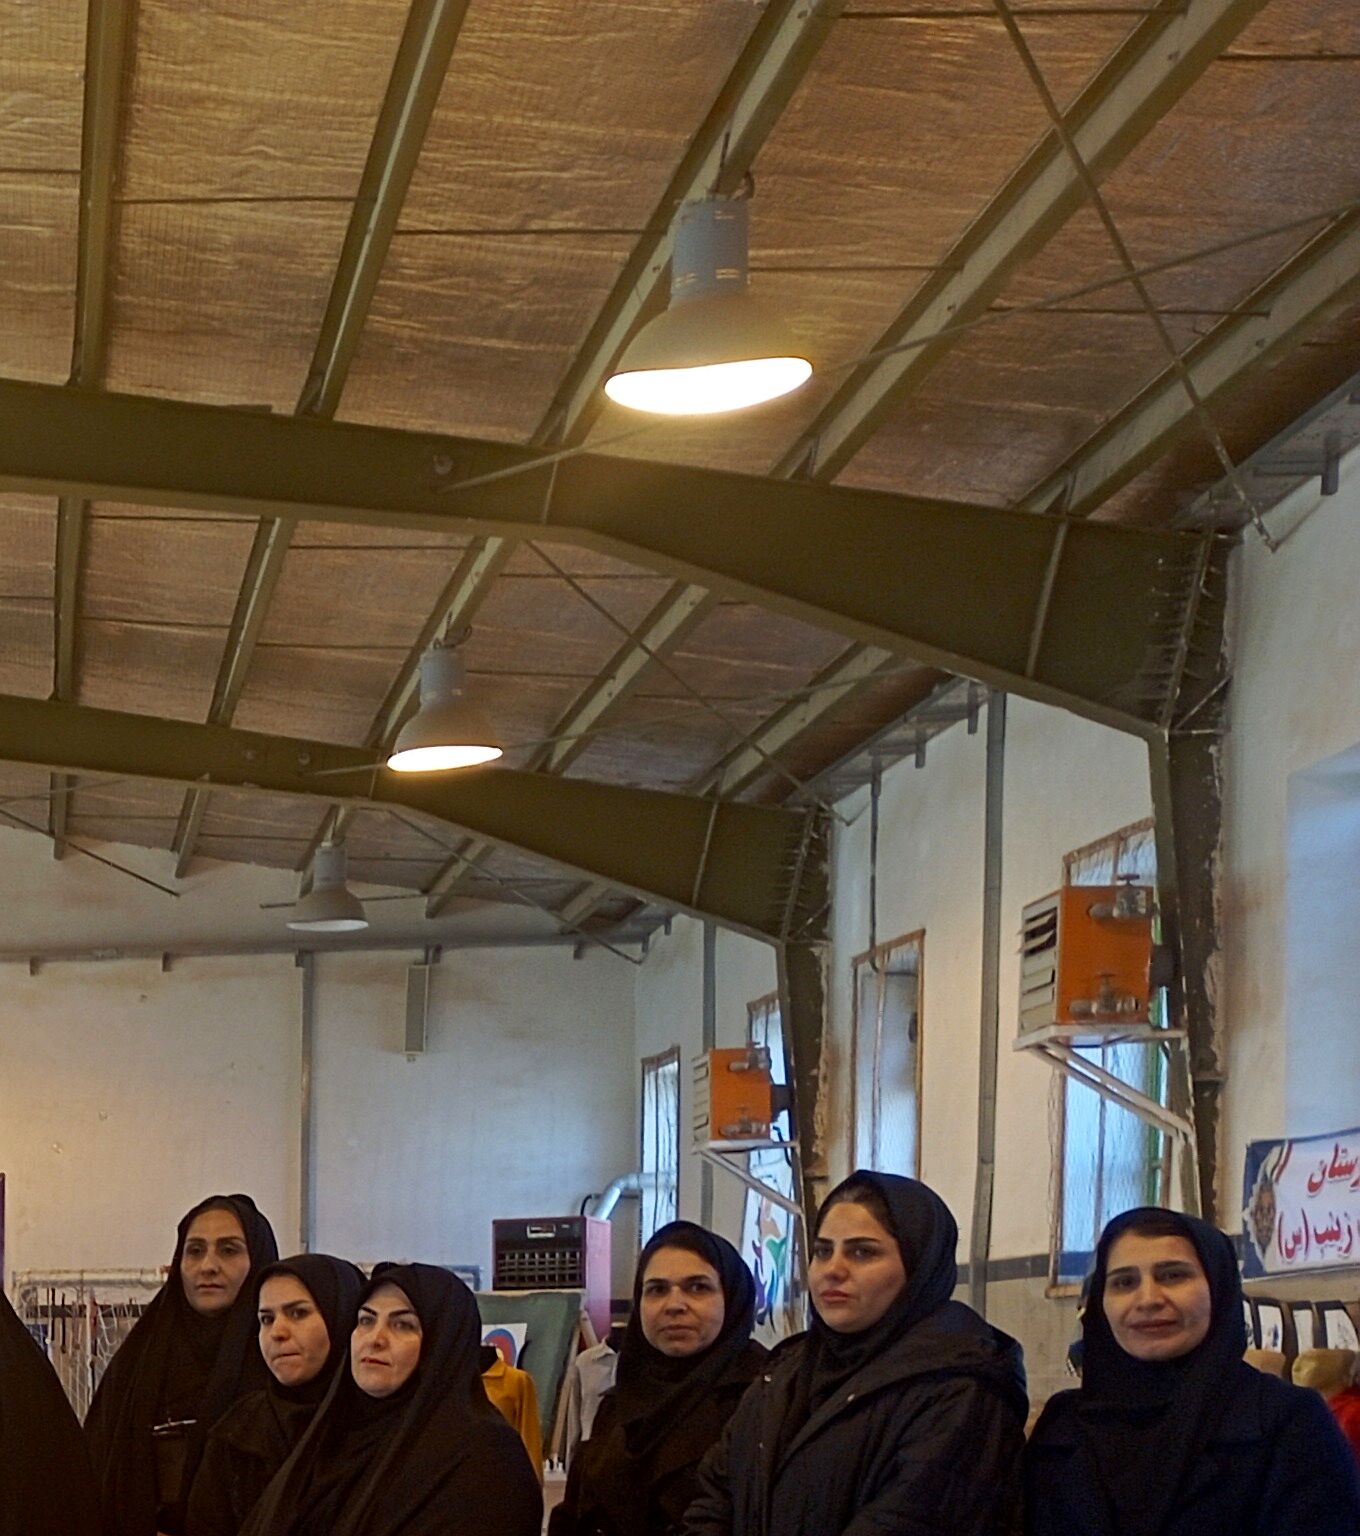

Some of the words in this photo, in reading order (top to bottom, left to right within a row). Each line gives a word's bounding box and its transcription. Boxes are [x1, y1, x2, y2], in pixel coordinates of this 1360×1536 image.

[1307, 1142, 1360, 1194] رستان
[1278, 1208, 1310, 1261] (س)
[1313, 1210, 1353, 1259] زینب
